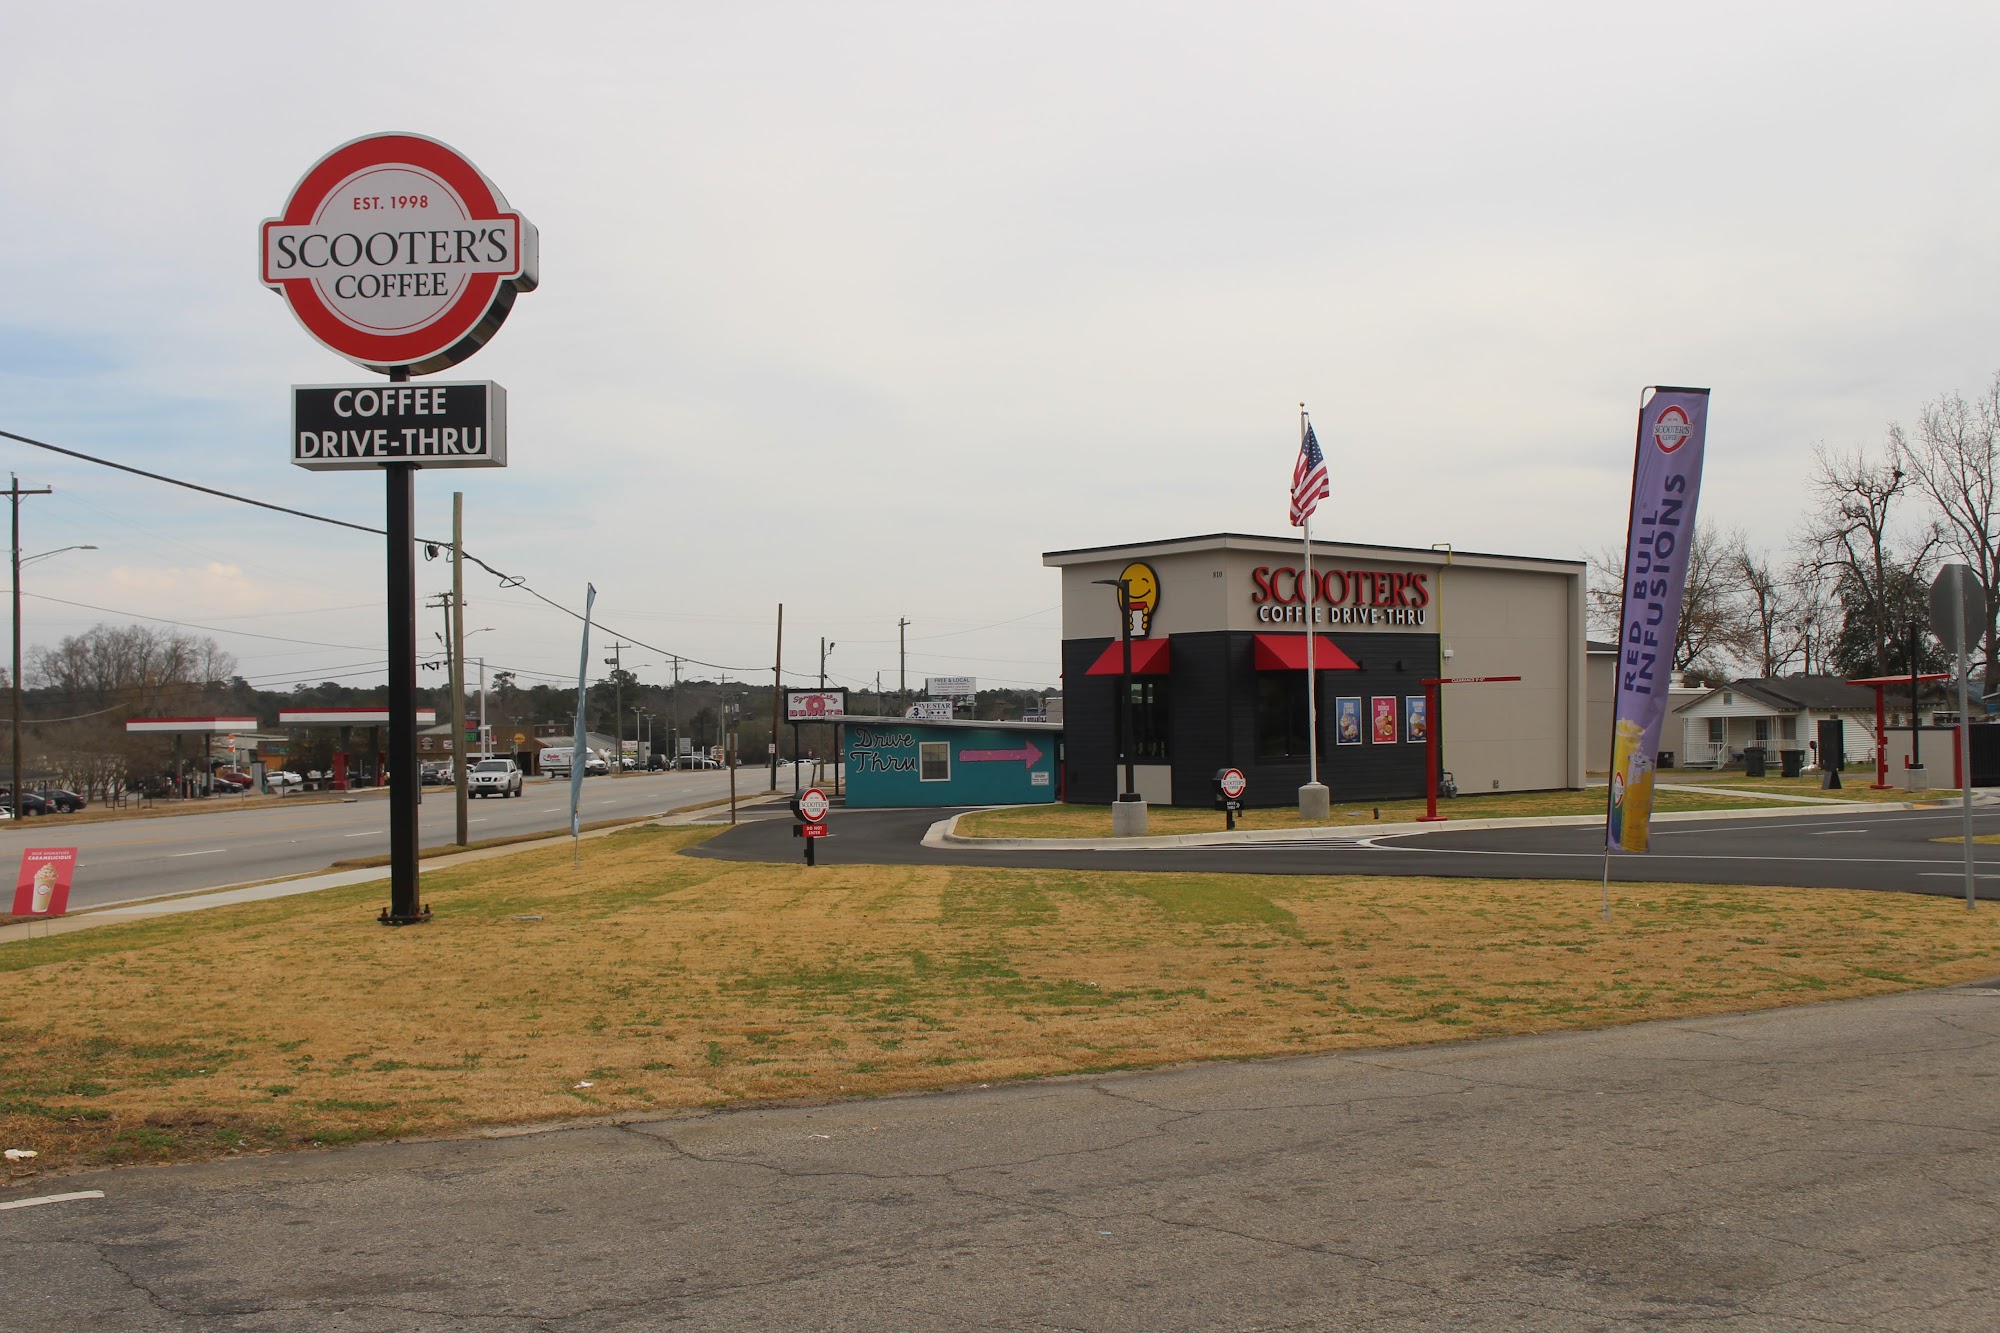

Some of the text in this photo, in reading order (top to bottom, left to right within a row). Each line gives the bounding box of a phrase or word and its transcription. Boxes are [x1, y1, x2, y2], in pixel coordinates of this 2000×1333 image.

[353, 195, 428, 210] EST. 1998
[277, 228, 508, 269] SCOOTER'S
[335, 272, 449, 299] COFFEE
[333, 388, 447, 418] COFFEE
[300, 427, 482, 458] DRIVE-THRU
[1212, 570, 1223, 579] 810
[1251, 566, 1430, 607] SCOOTER'S
[1635, 474, 1686, 695] INFUSIONS
[1624, 509, 1658, 692] RED BULL
[1258, 605, 1427, 625] COFFE DRIVE-THRU
[853, 727, 916, 749] Drive
[849, 750, 918, 773] Thru
